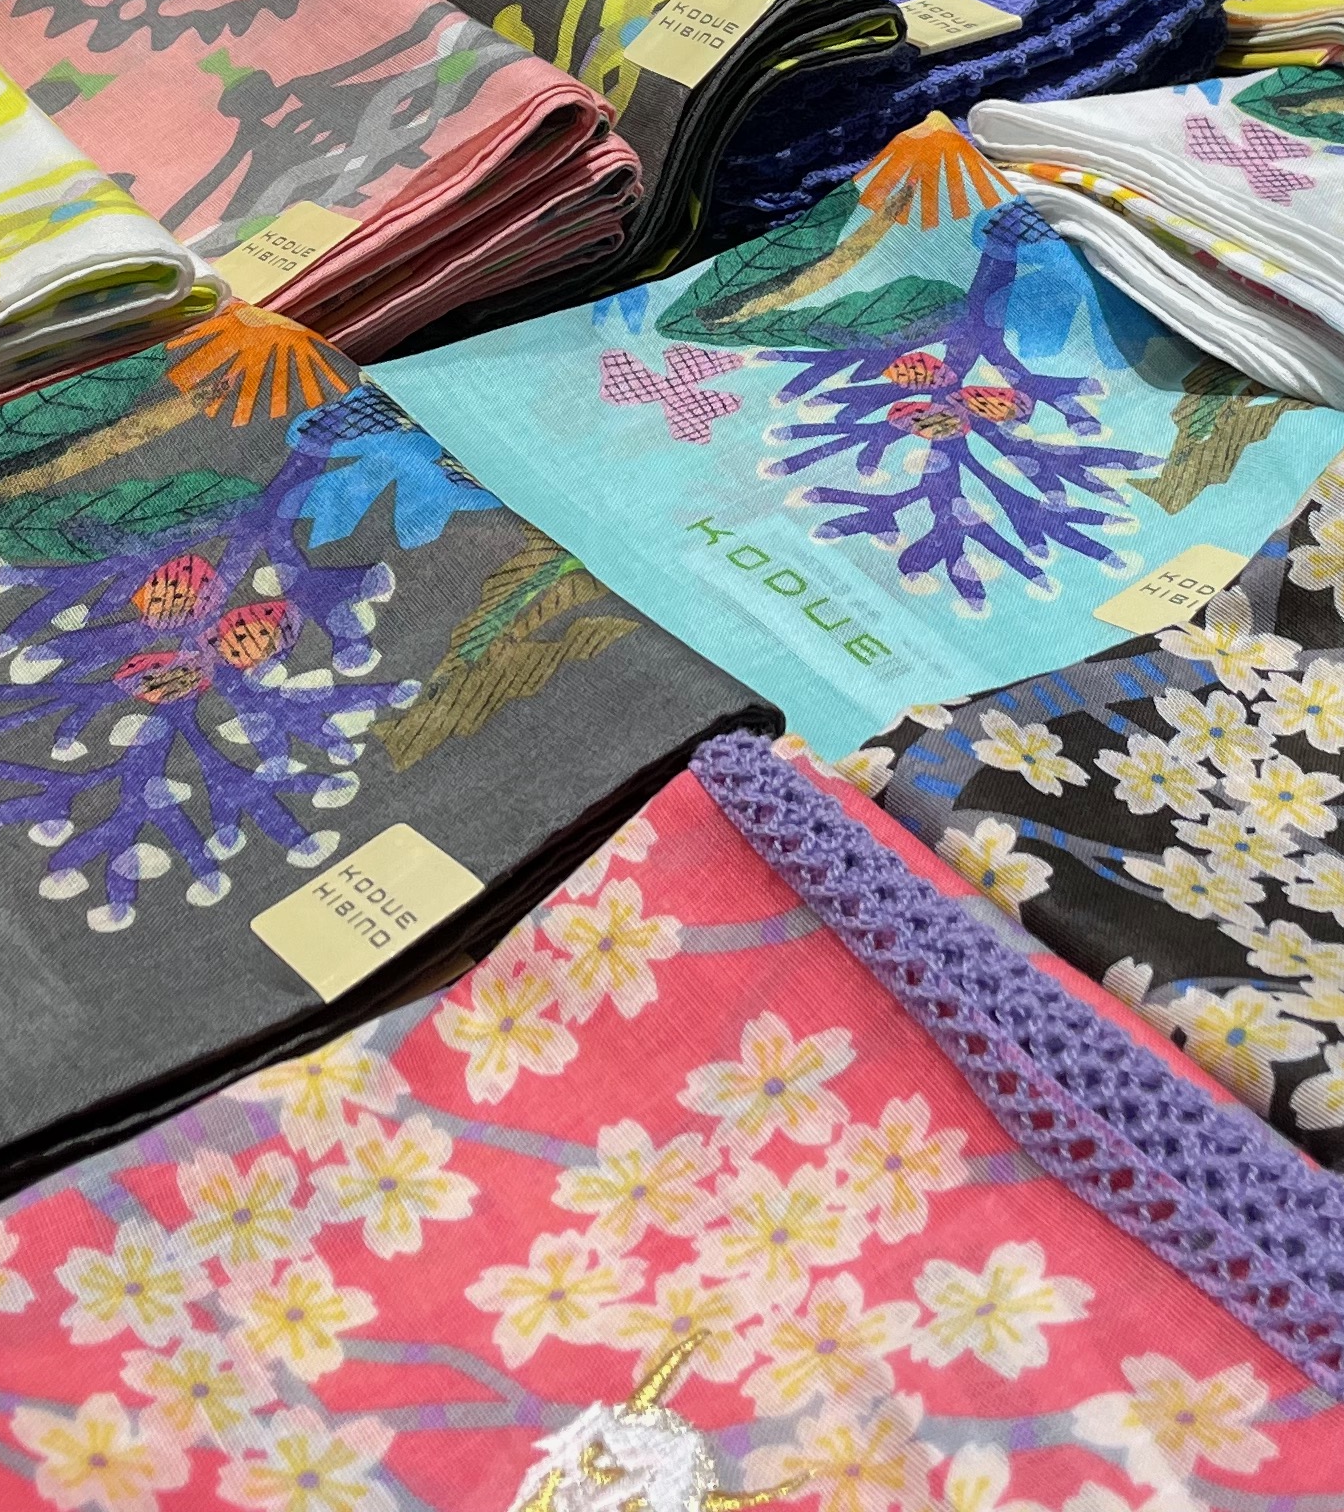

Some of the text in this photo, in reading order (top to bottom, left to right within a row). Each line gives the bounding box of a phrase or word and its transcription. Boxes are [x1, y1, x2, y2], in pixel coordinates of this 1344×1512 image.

[672, 1, 740, 35] KODUE
[903, 4, 962, 34] HIBINO
[917, 0, 977, 29] KODUE
[658, 16, 726, 50] HIBINO
[242, 242, 298, 272] HIBINO
[260, 230, 316, 258] KODUE
[685, 515, 893, 668] KODUE
[1139, 583, 1200, 609] HIBI
[1157, 571, 1216, 596] KOD
[337, 864, 418, 931] KODUE
[311, 882, 392, 950] HIBINO
